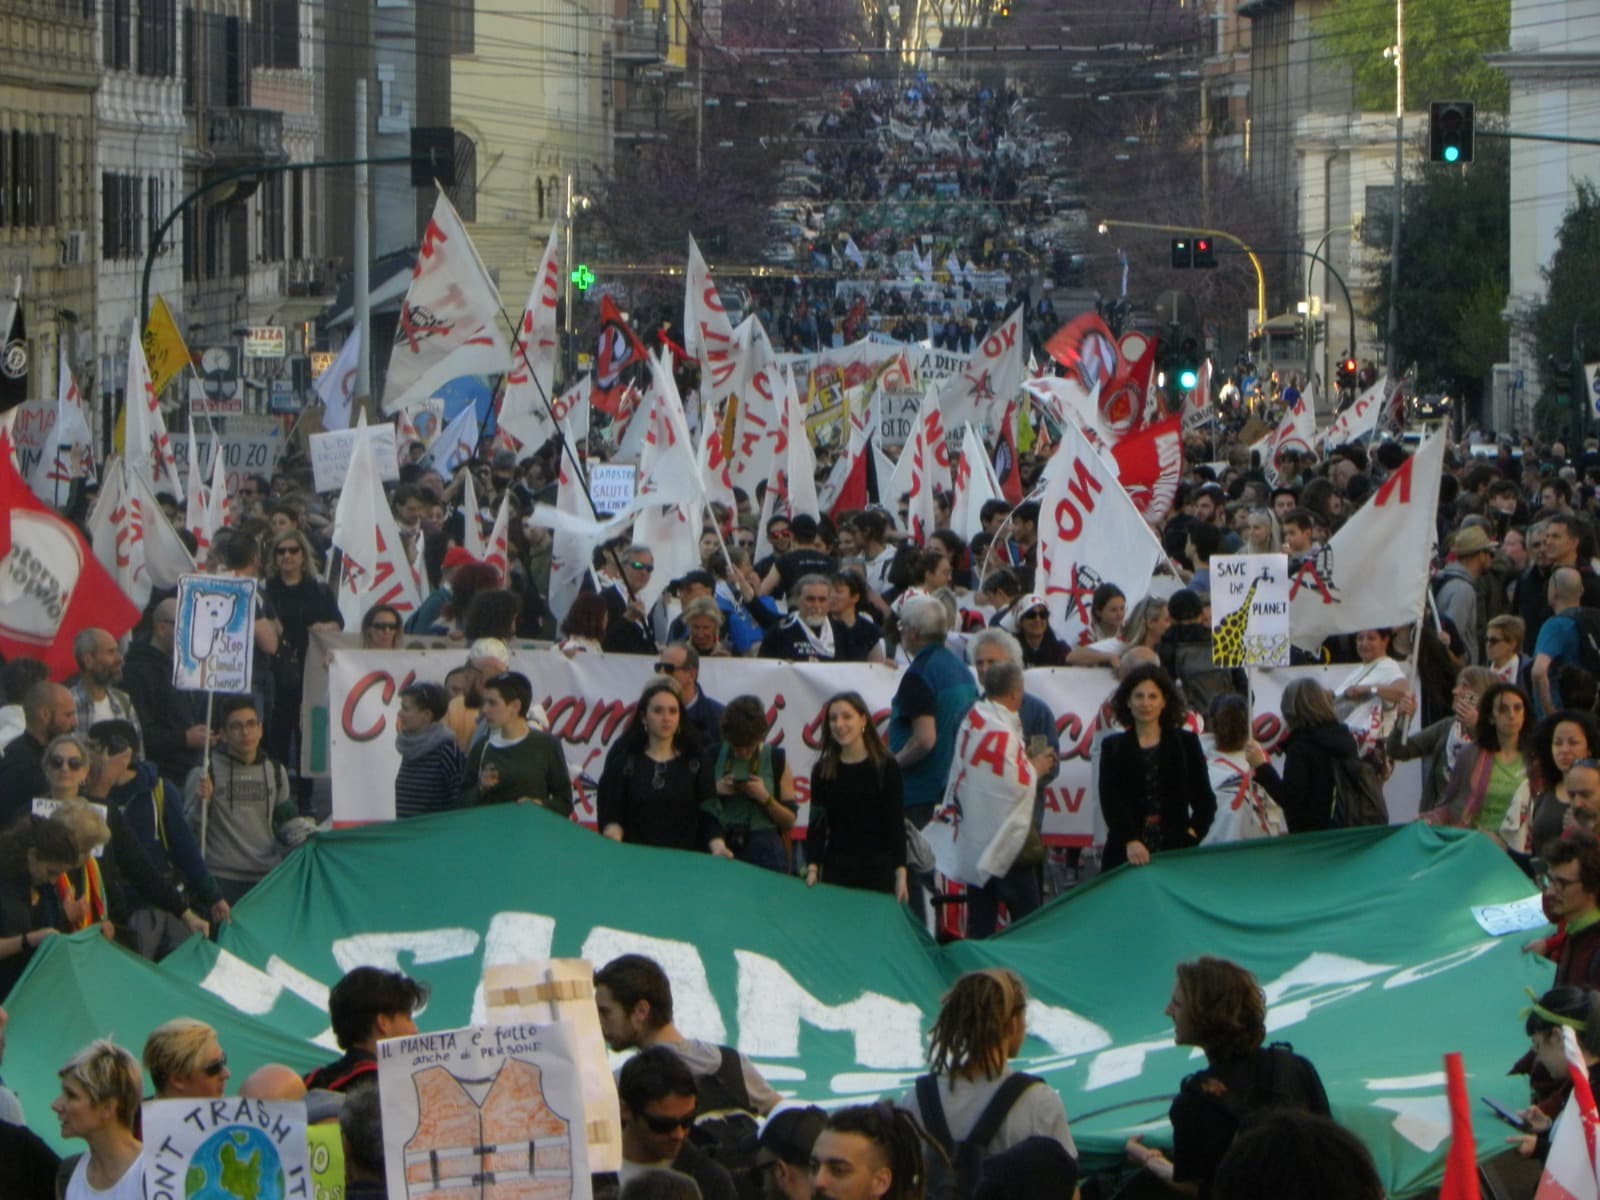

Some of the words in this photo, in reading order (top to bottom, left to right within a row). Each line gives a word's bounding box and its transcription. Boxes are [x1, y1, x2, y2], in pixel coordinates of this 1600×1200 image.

[1217, 562, 1246, 577] SAVE
[1230, 581, 1244, 595] the
[1252, 601, 1286, 617] PLANET
[219, 635, 243, 656] Stop
[207, 655, 243, 673] Climate
[207, 673, 241, 689] Change
[400, 1033, 456, 1055] PIANETA
[494, 1024, 537, 1048] fatto
[412, 1051, 450, 1066] anche
[481, 1041, 543, 1060] PERSONE
[183, 1097, 292, 1145] TRASH
